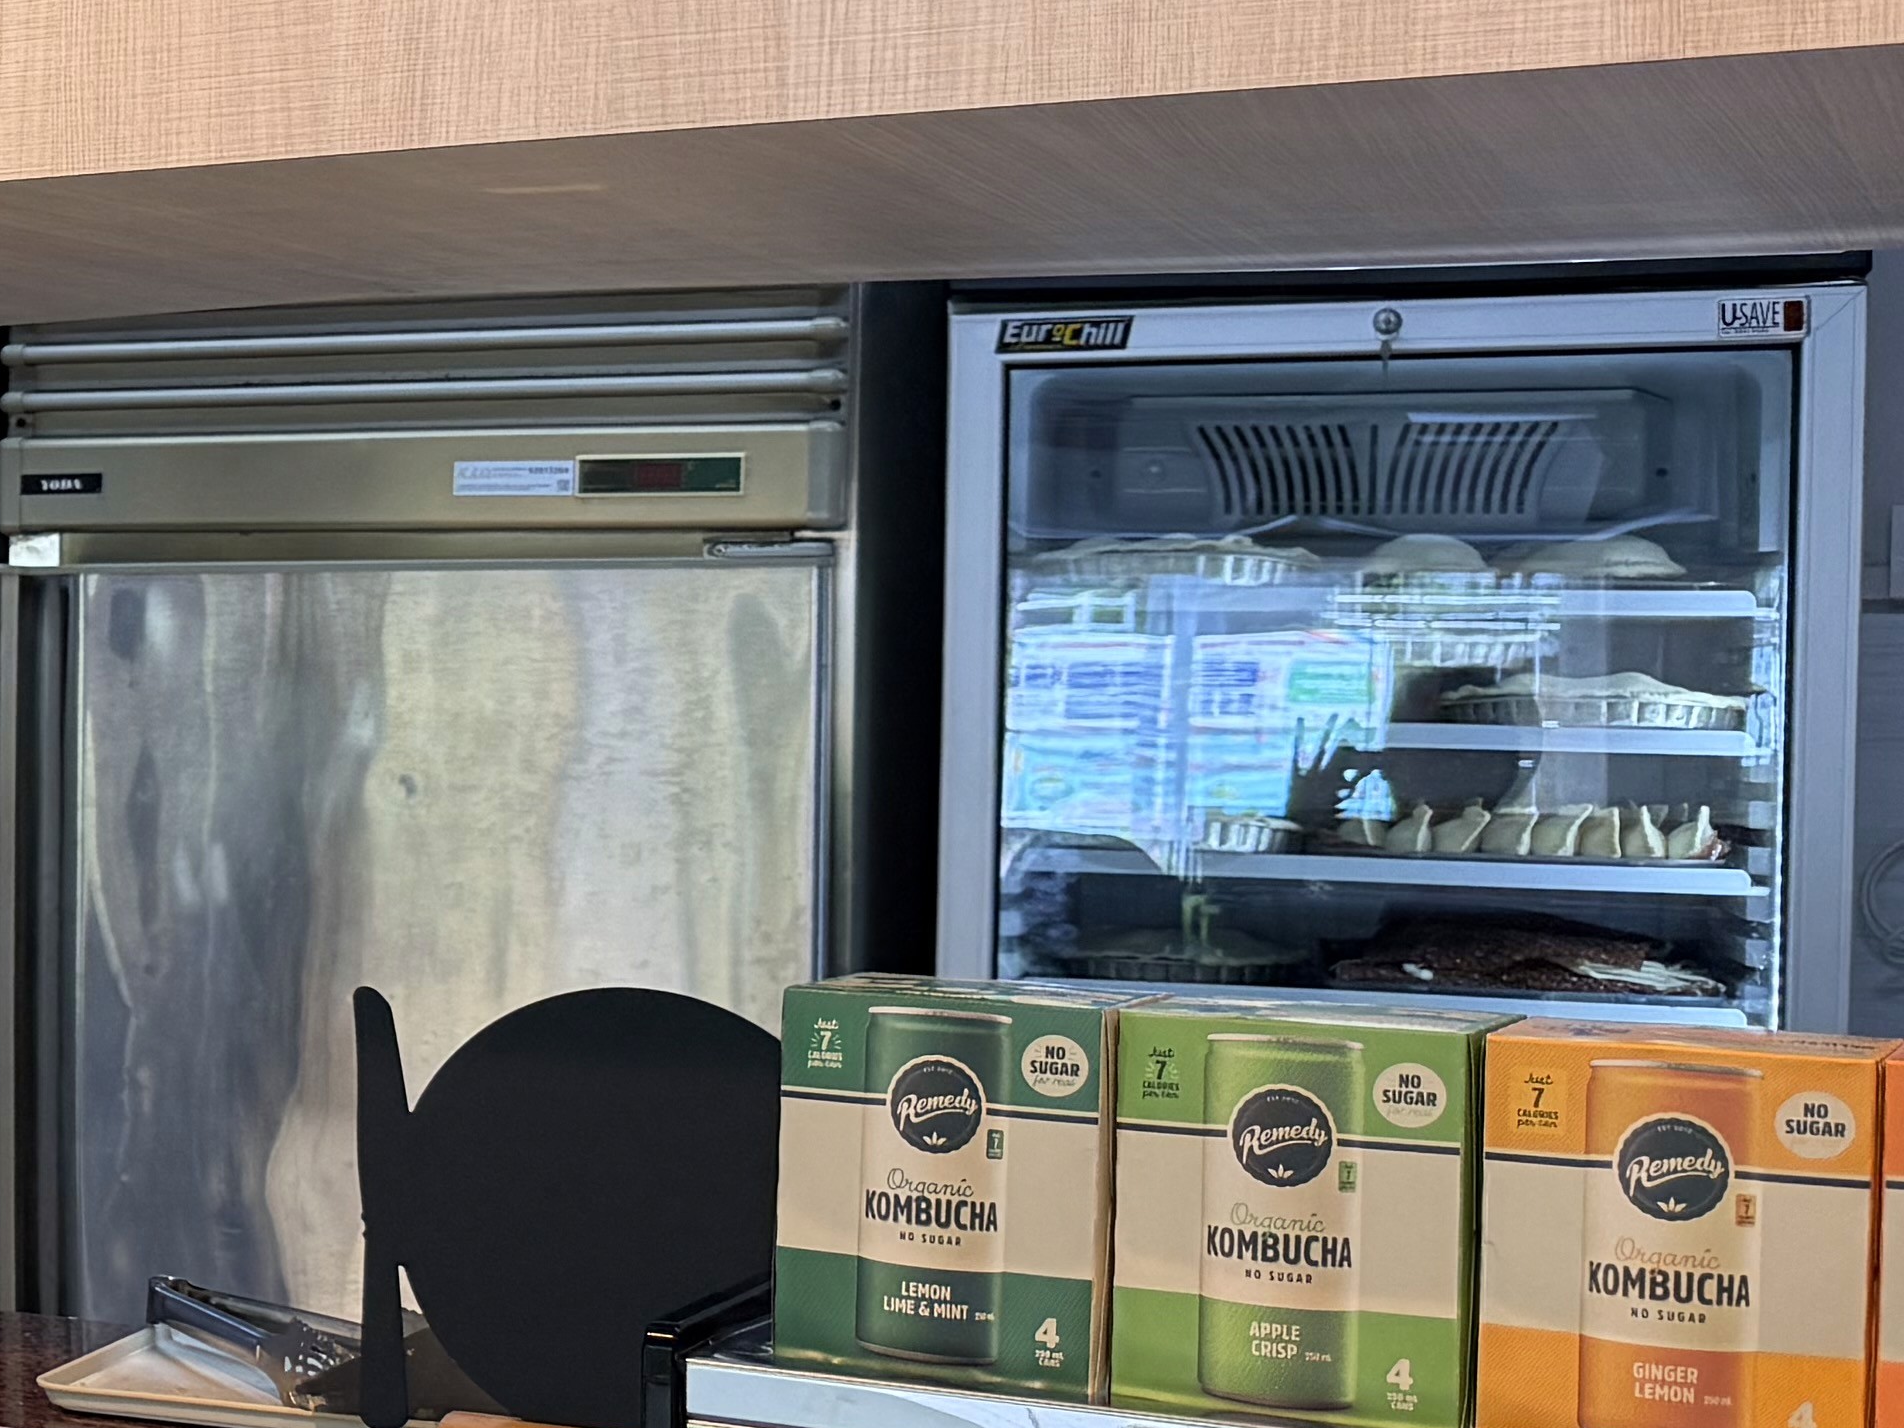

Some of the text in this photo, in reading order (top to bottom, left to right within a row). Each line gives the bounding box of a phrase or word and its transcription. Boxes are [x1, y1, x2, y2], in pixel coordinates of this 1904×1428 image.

[1722, 301, 1779, 326] U-SAVE
[814, 1018, 839, 1029] Just
[820, 1031, 830, 1050] 7
[1044, 1046, 1065, 1060] NO
[1148, 1047, 1175, 1058] Just
[1030, 1060, 1080, 1076] SUGAR
[1156, 1060, 1167, 1080] 7
[1399, 1074, 1421, 1088] NO
[1382, 1089, 1437, 1106] SUGAR
[1531, 1088, 1545, 1108] 7
[897, 1088, 978, 1130] Remedy
[1804, 1103, 1828, 1119] NO
[1785, 1119, 1846, 1138] SUGAR
[1239, 1118, 1328, 1164] Remedy
[1626, 1148, 1725, 1197] Remedy
[887, 1168, 974, 1198] Organic
[865, 1189, 998, 1232] KOMBUCHA
[1231, 1203, 1326, 1233] Organic
[900, 1231, 962, 1246] NO SUGAR
[1207, 1225, 1352, 1268] KOMBUCHA
[1614, 1236, 1721, 1270] Organic
[1245, 1269, 1312, 1284] NO SUGAR
[1589, 1261, 1750, 1307] KOMBUCHA
[901, 1281, 951, 1300] LEMON
[884, 1296, 914, 1314] LIME
[919, 1301, 930, 1316] &
[934, 1303, 968, 1320] MINT
[1631, 1307, 1706, 1323] NO SUGAR
[1035, 1318, 1059, 1348] 4
[1250, 1321, 1300, 1341] APPLE
[1252, 1341, 1297, 1359] CRISP
[1387, 1359, 1413, 1390] 4
[1633, 1362, 1698, 1384] GINGER
[1635, 1382, 1695, 1404] LEMON
